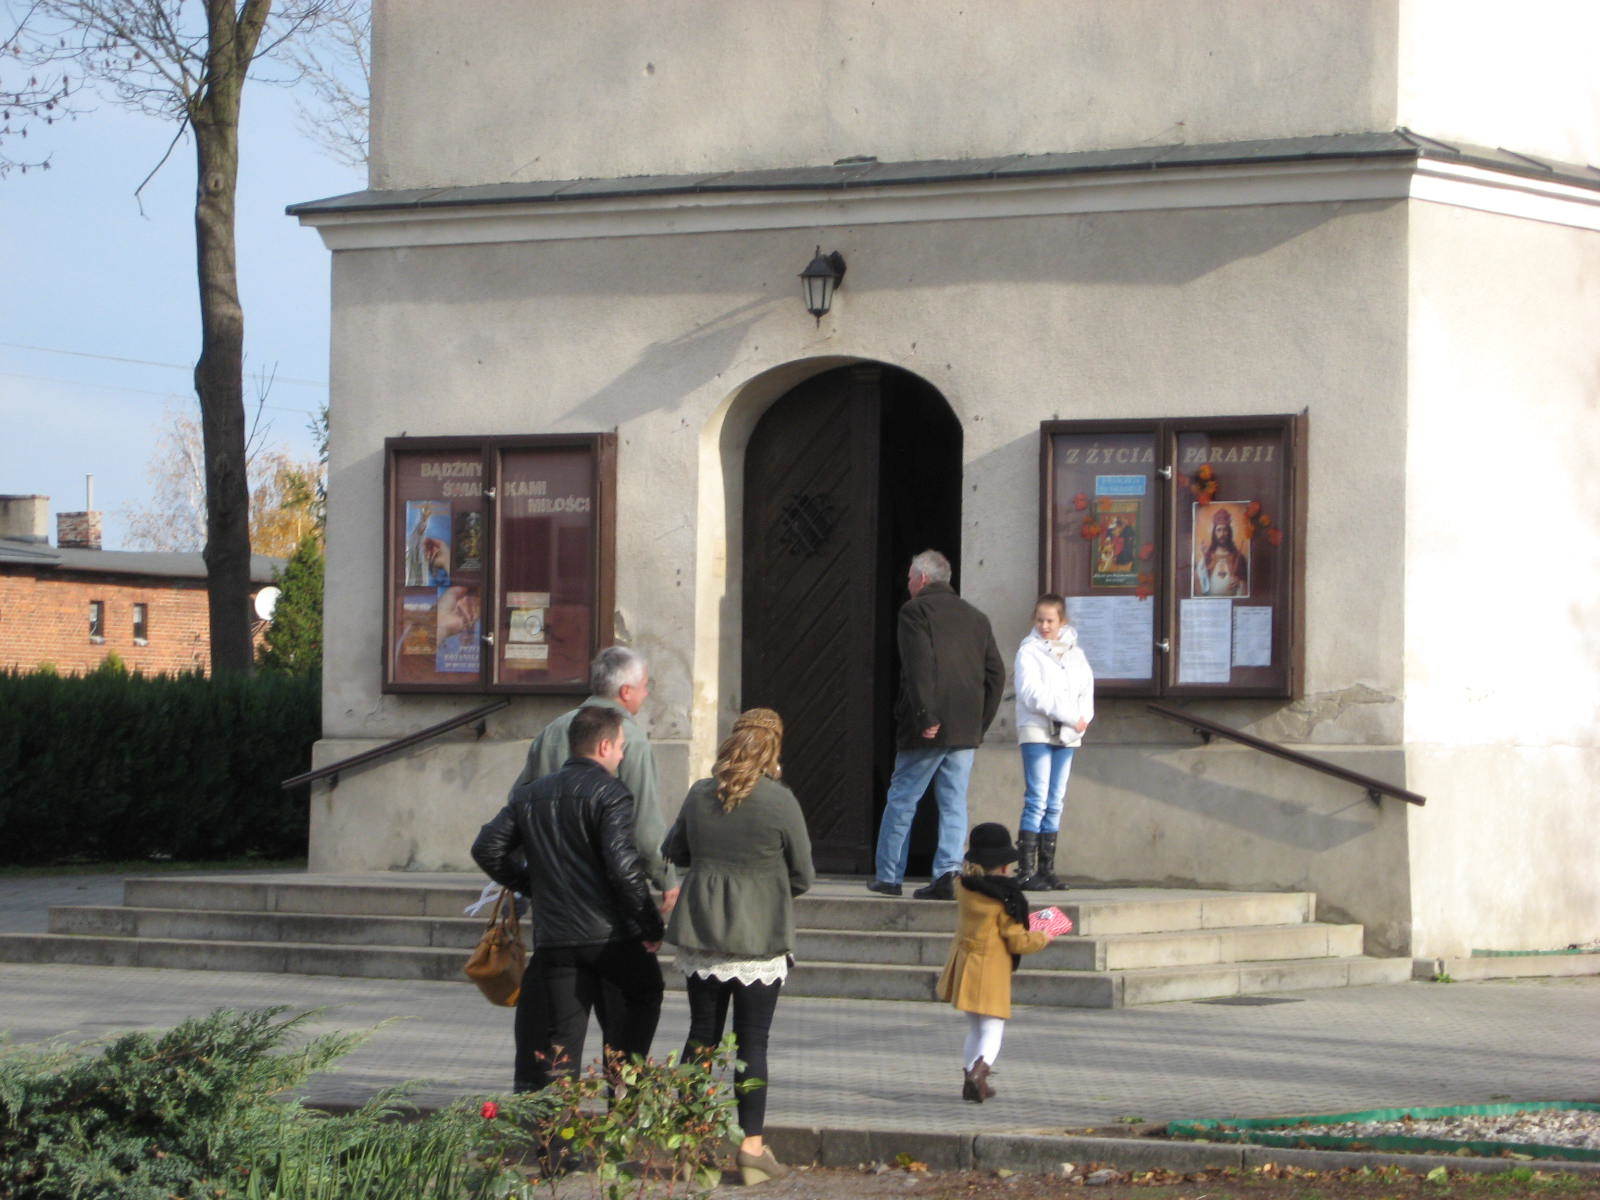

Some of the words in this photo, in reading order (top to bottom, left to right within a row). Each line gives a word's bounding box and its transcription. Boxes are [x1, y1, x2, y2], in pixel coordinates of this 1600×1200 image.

[1064, 447, 1081, 464] Z
[1085, 442, 1155, 464] ŻYCIA
[1183, 445, 1276, 464] PARAFII
